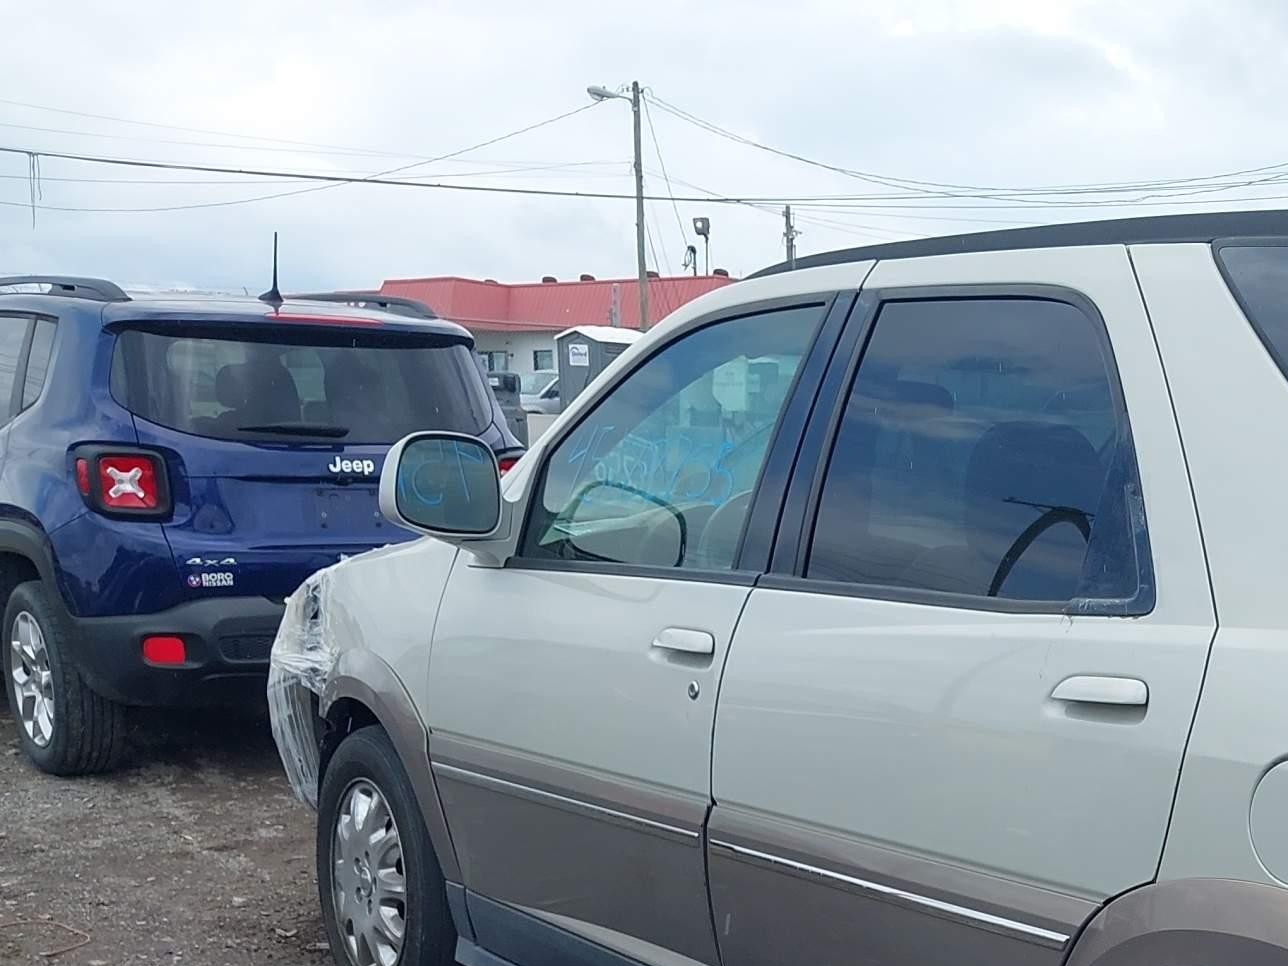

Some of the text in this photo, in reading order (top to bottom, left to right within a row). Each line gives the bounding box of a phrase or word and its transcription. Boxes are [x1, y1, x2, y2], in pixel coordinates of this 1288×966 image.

[328, 456, 375, 475] Jeep
[185, 557, 238, 567] 4x4
[201, 572, 234, 581] BORO
